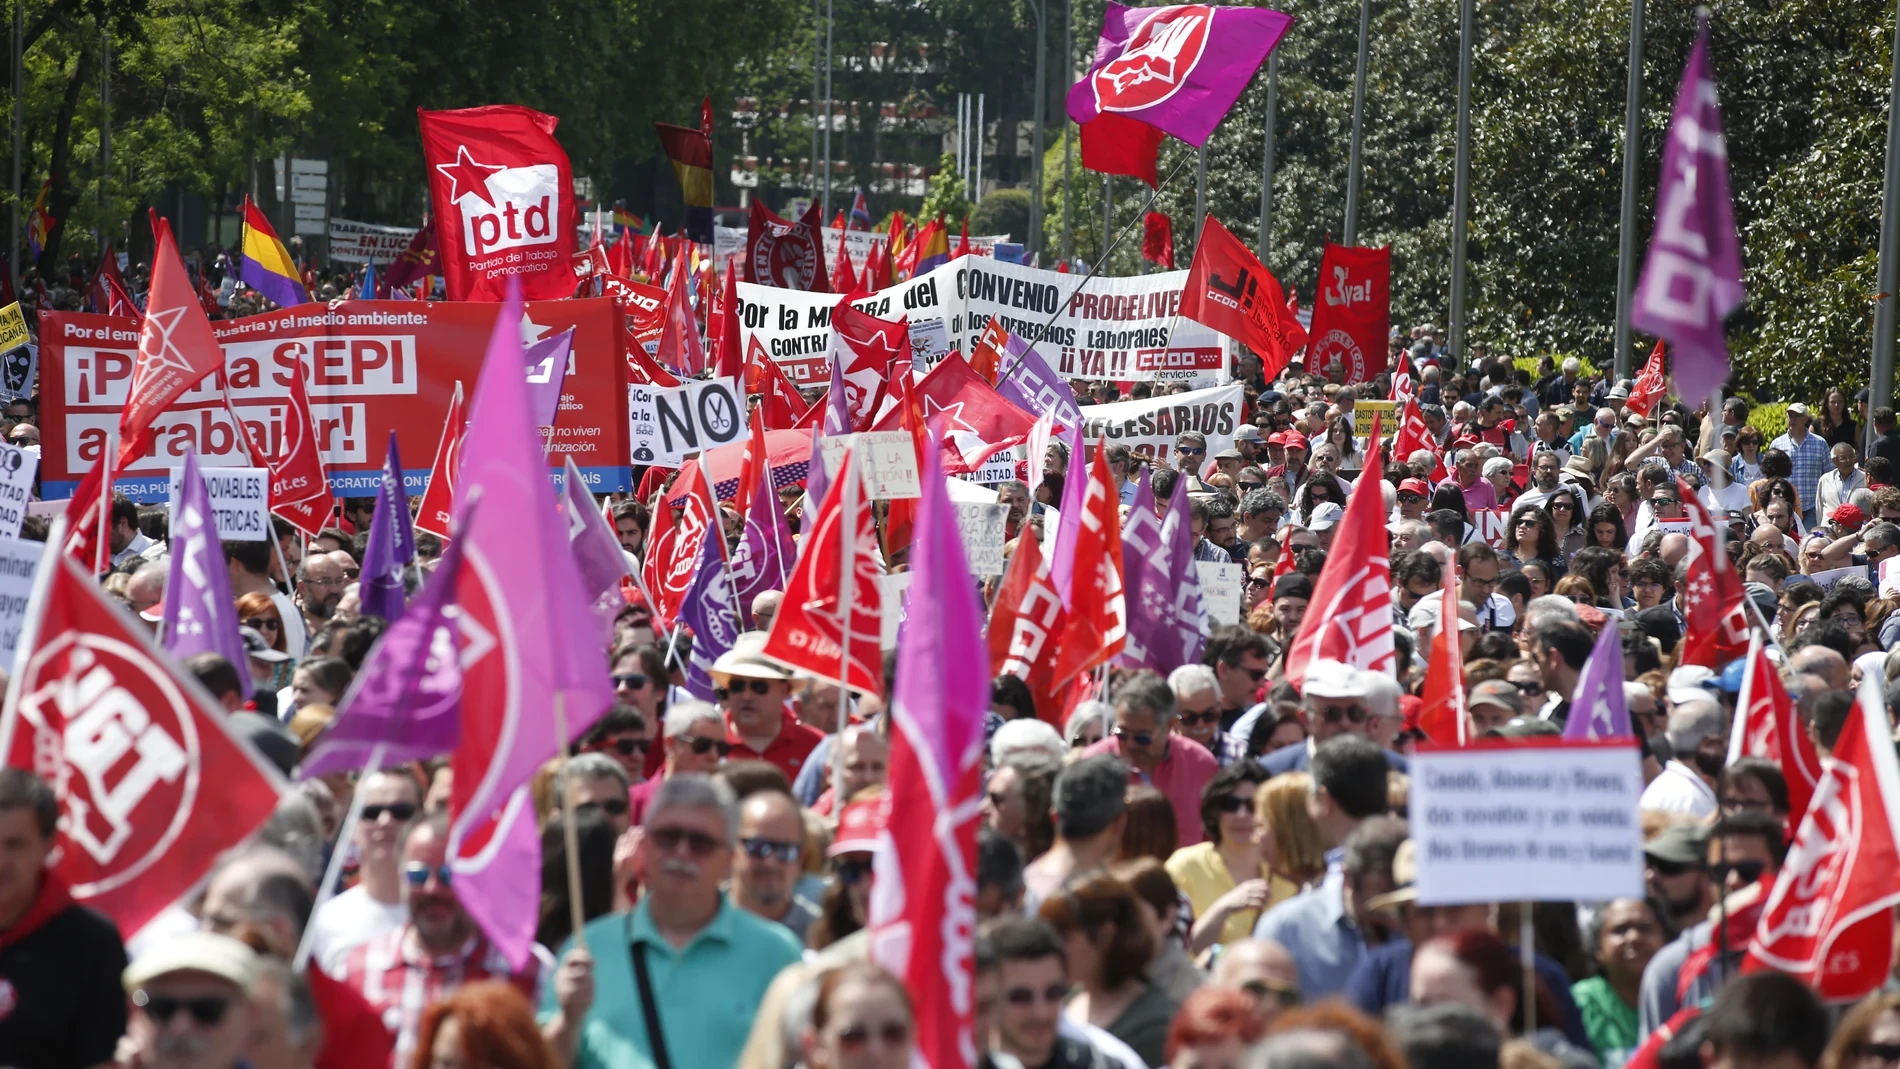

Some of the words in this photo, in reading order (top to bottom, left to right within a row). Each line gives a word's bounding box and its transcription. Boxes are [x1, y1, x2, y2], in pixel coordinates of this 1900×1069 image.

[470, 195, 551, 247] ptd
[359, 235, 379, 248] EN
[469, 256, 507, 273] Partido
[507, 253, 523, 266] del
[524, 249, 558, 264] Trabajo
[487, 262, 548, 280] Democrático
[778, 303, 799, 331] la
[904, 276, 939, 311] del
[957, 268, 1059, 315] CONVENIO
[1207, 290, 1239, 309] CCOO
[64, 324, 92, 339] Por
[95, 326, 110, 340] el
[269, 319, 278, 333] y
[280, 315, 294, 328] el
[297, 312, 345, 327] medio
[348, 310, 428, 326] ambiente:
[968, 312, 992, 331] los
[272, 338, 404, 388] SEPI
[1139, 351, 1196, 369] CCOO
[1153, 369, 1198, 380] servicios
[631, 411, 638, 421] a
[641, 408, 651, 421] la
[654, 383, 740, 454] NO
[1355, 409, 1375, 420] GASTOS
[557, 428, 571, 437] no
[573, 427, 601, 437] viven
[969, 468, 1014, 482] AMISTAD.
